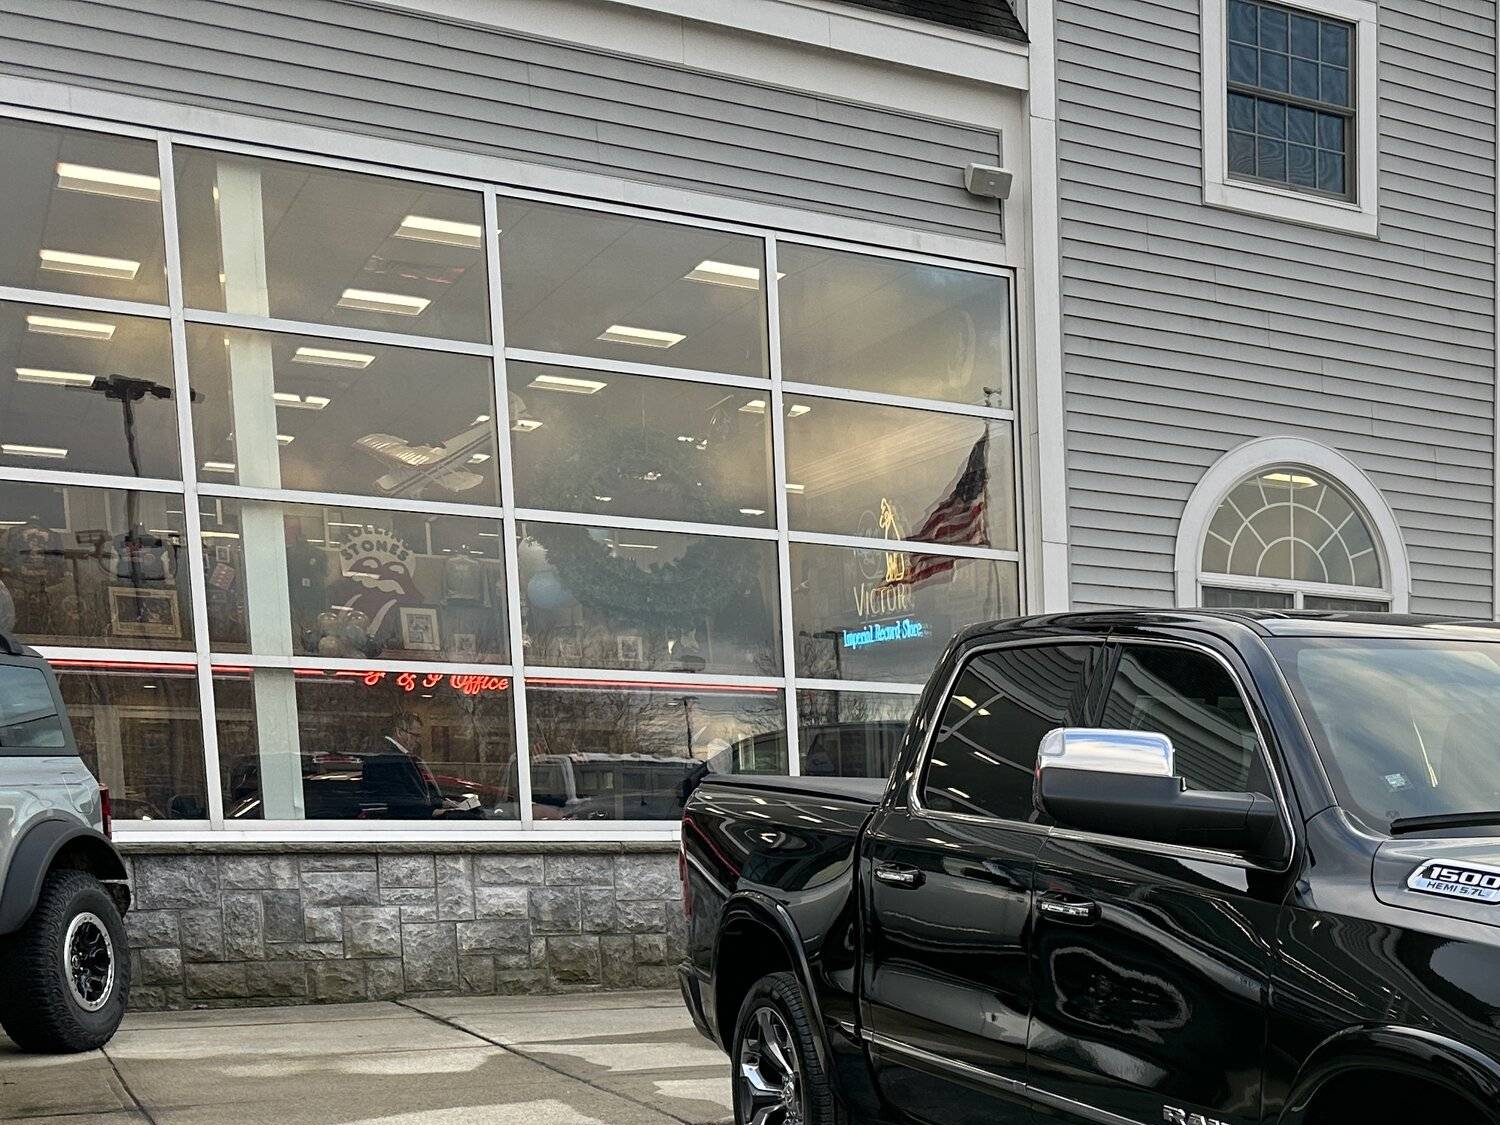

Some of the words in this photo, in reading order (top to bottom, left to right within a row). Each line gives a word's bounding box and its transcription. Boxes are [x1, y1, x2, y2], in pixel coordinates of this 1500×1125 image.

[341, 539, 409, 561] STONES
[853, 583, 907, 617] VICTOR
[843, 623, 874, 649] Imperial
[874, 620, 901, 642] Record
[901, 617, 923, 639] Store
[1426, 880, 1459, 892] HEMI
[1459, 884, 1487, 897] 5.7L
